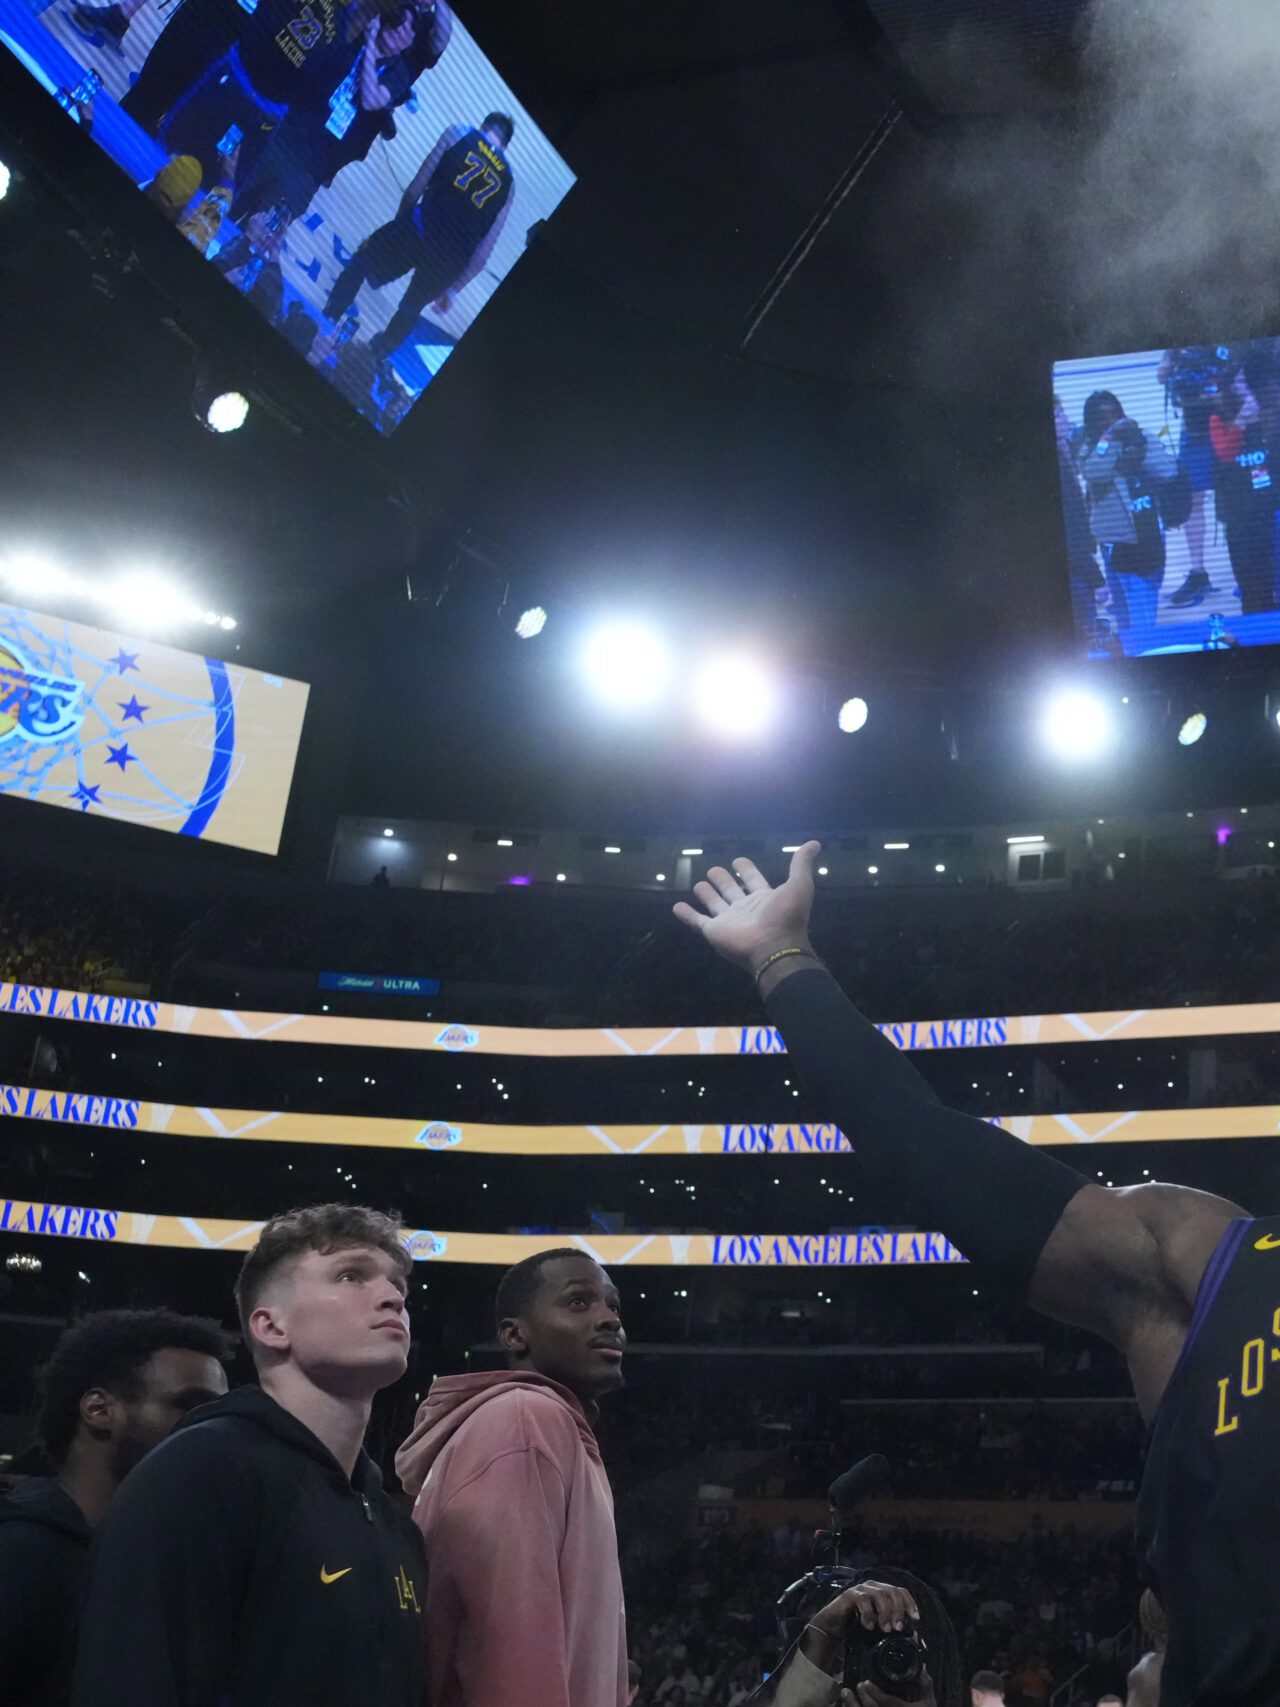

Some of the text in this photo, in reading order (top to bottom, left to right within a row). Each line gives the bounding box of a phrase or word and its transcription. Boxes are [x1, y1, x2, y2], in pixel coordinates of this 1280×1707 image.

[453, 151, 503, 209] 77
[383, 979, 420, 991] ULTRA
[48, 989, 158, 1029] LAKERS
[908, 1016, 1007, 1049] LAKERS
[24, 1087, 140, 1127] LAKERS
[722, 1124, 774, 1153] LOS
[0, 1200, 118, 1240] LAKERS
[711, 1236, 763, 1264] LOS
[766, 1234, 886, 1264] ANGELES
